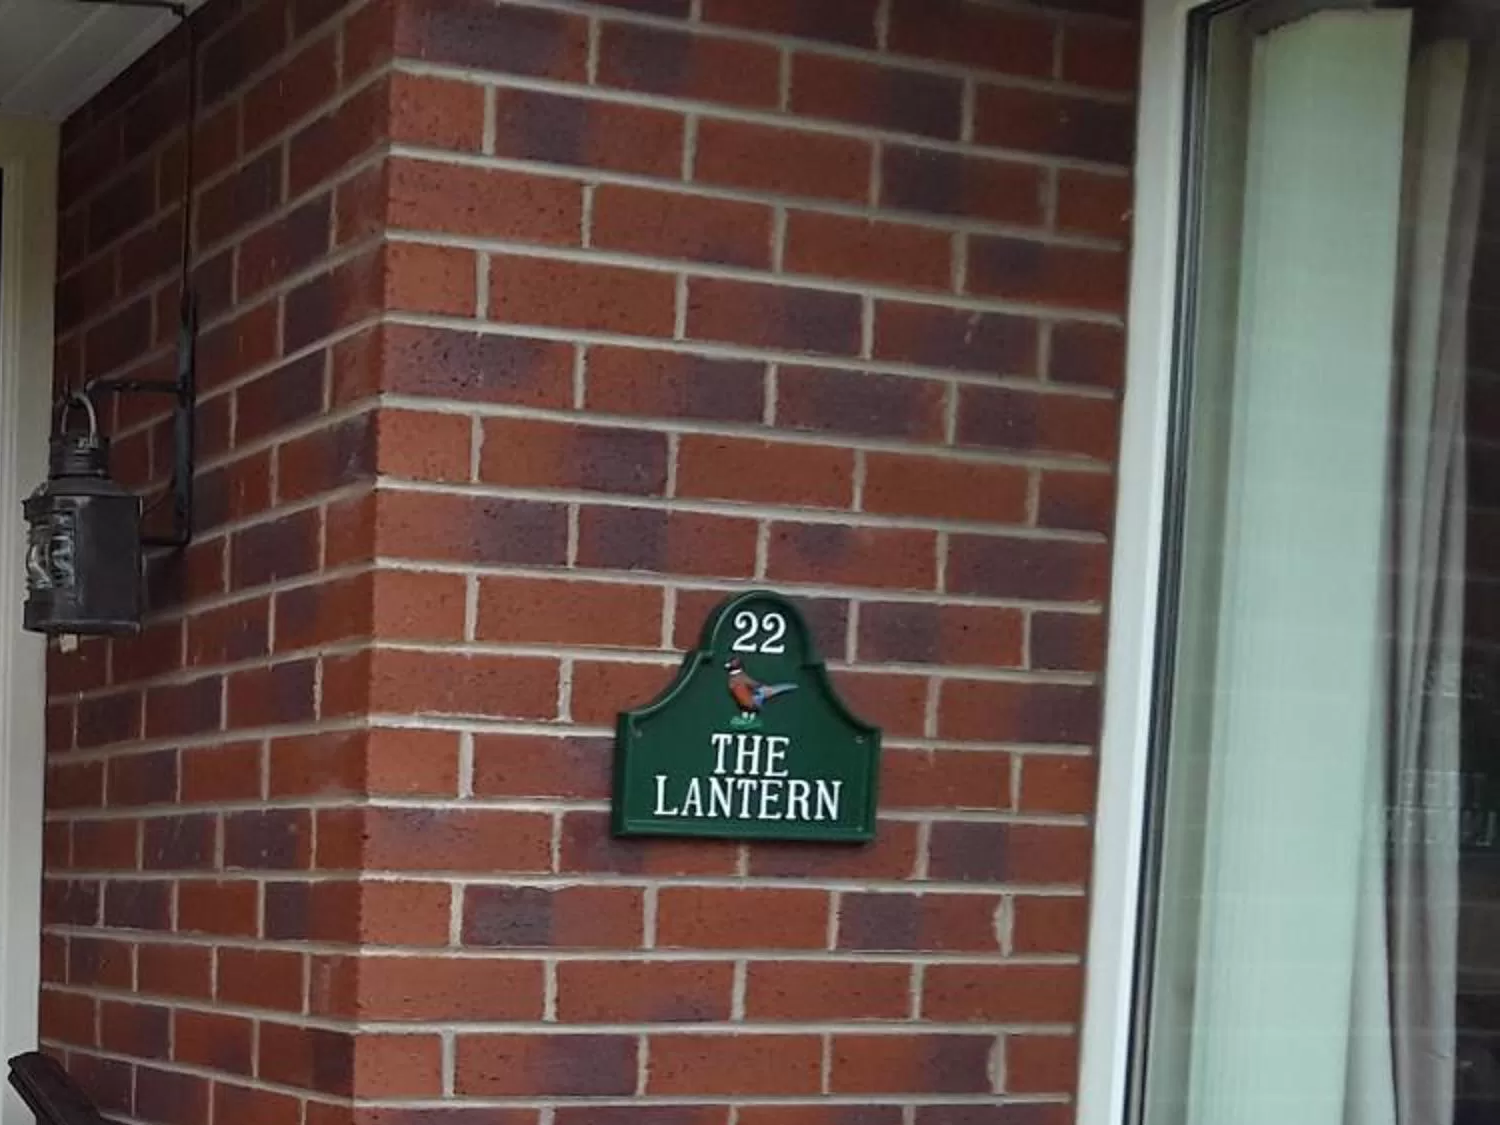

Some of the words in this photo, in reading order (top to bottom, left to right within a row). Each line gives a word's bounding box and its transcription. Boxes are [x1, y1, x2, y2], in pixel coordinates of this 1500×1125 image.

[731, 610, 787, 654] 22
[711, 733, 790, 777] THE
[653, 775, 843, 821] LANTERN
